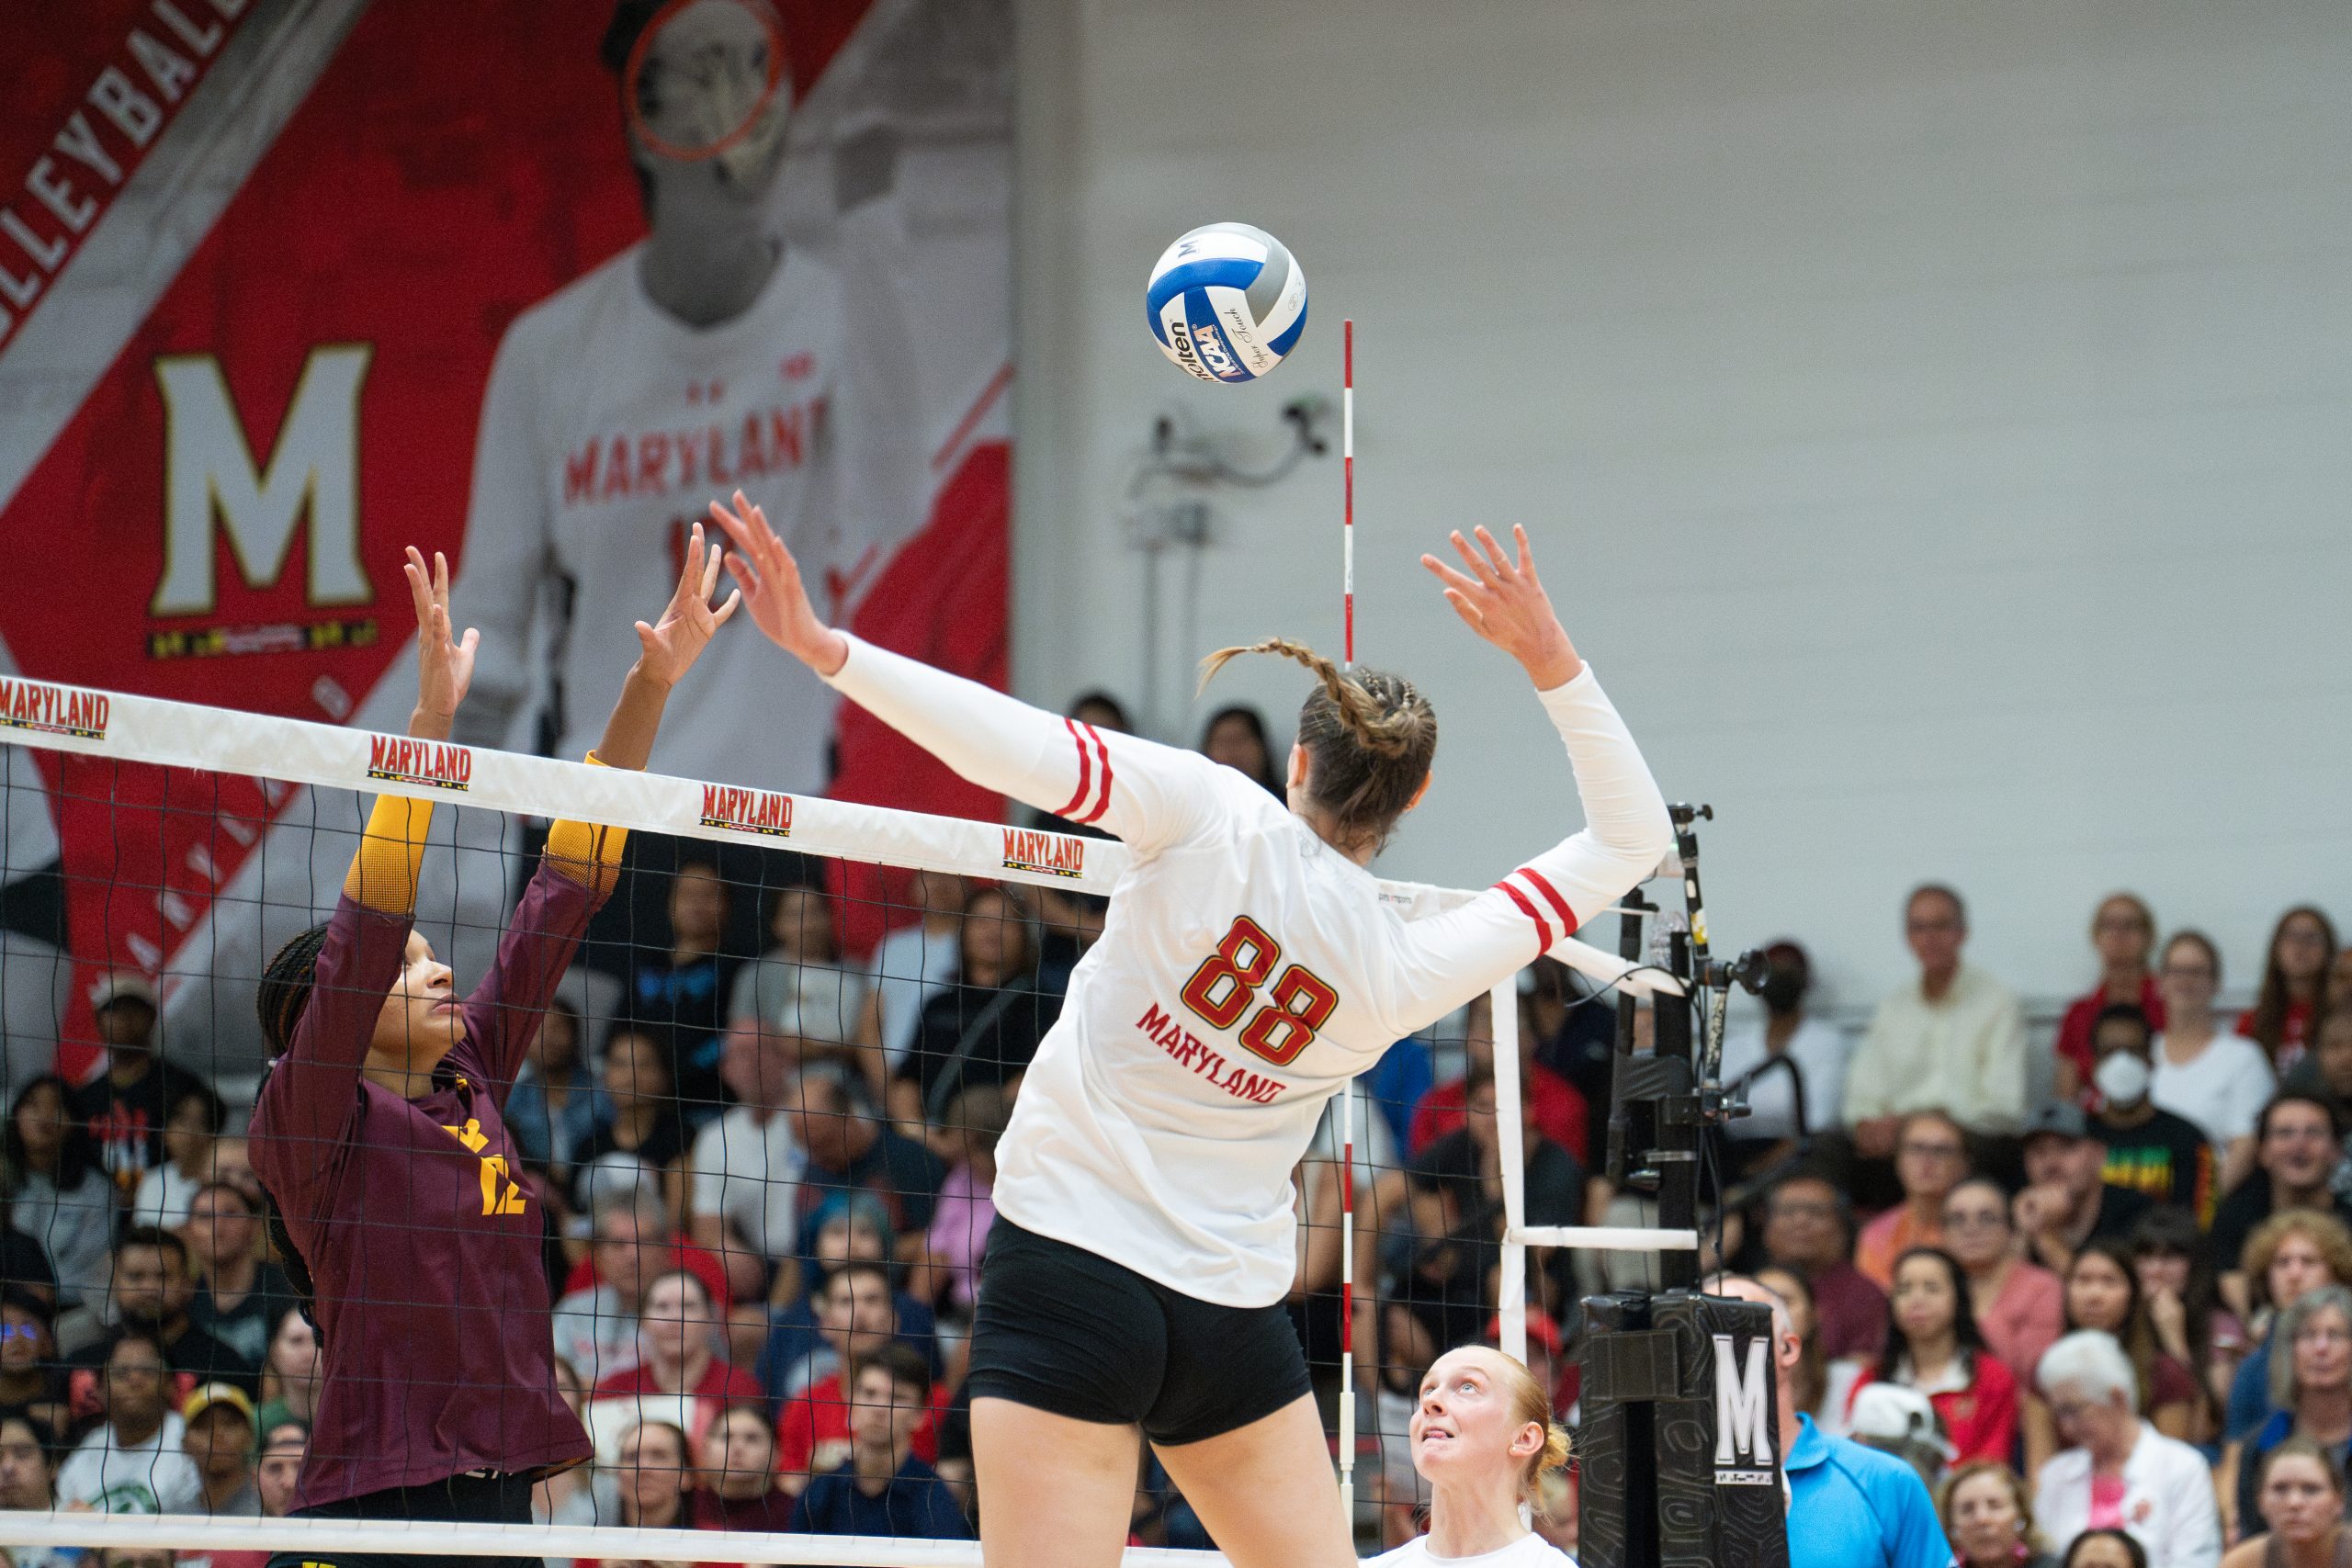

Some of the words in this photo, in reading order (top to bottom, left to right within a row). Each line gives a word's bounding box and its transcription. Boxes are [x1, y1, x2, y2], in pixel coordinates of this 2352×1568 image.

[0, 0, 250, 340] LLEYBAL
[1171, 321, 1220, 383] molten
[1193, 324, 1242, 378] NCAA
[1223, 308, 1252, 344] Touch
[150, 341, 374, 615] M
[0, 680, 109, 731] MARYLAND
[369, 735, 472, 784] MARYLAND
[702, 784, 793, 829] MARYLAND
[1002, 828, 1084, 871] MARYLAND
[1181, 915, 1339, 1066] 88
[1136, 1001, 1287, 1103] MARYLAND
[481, 1155, 526, 1215] 12
[1713, 1335, 1773, 1466] M
